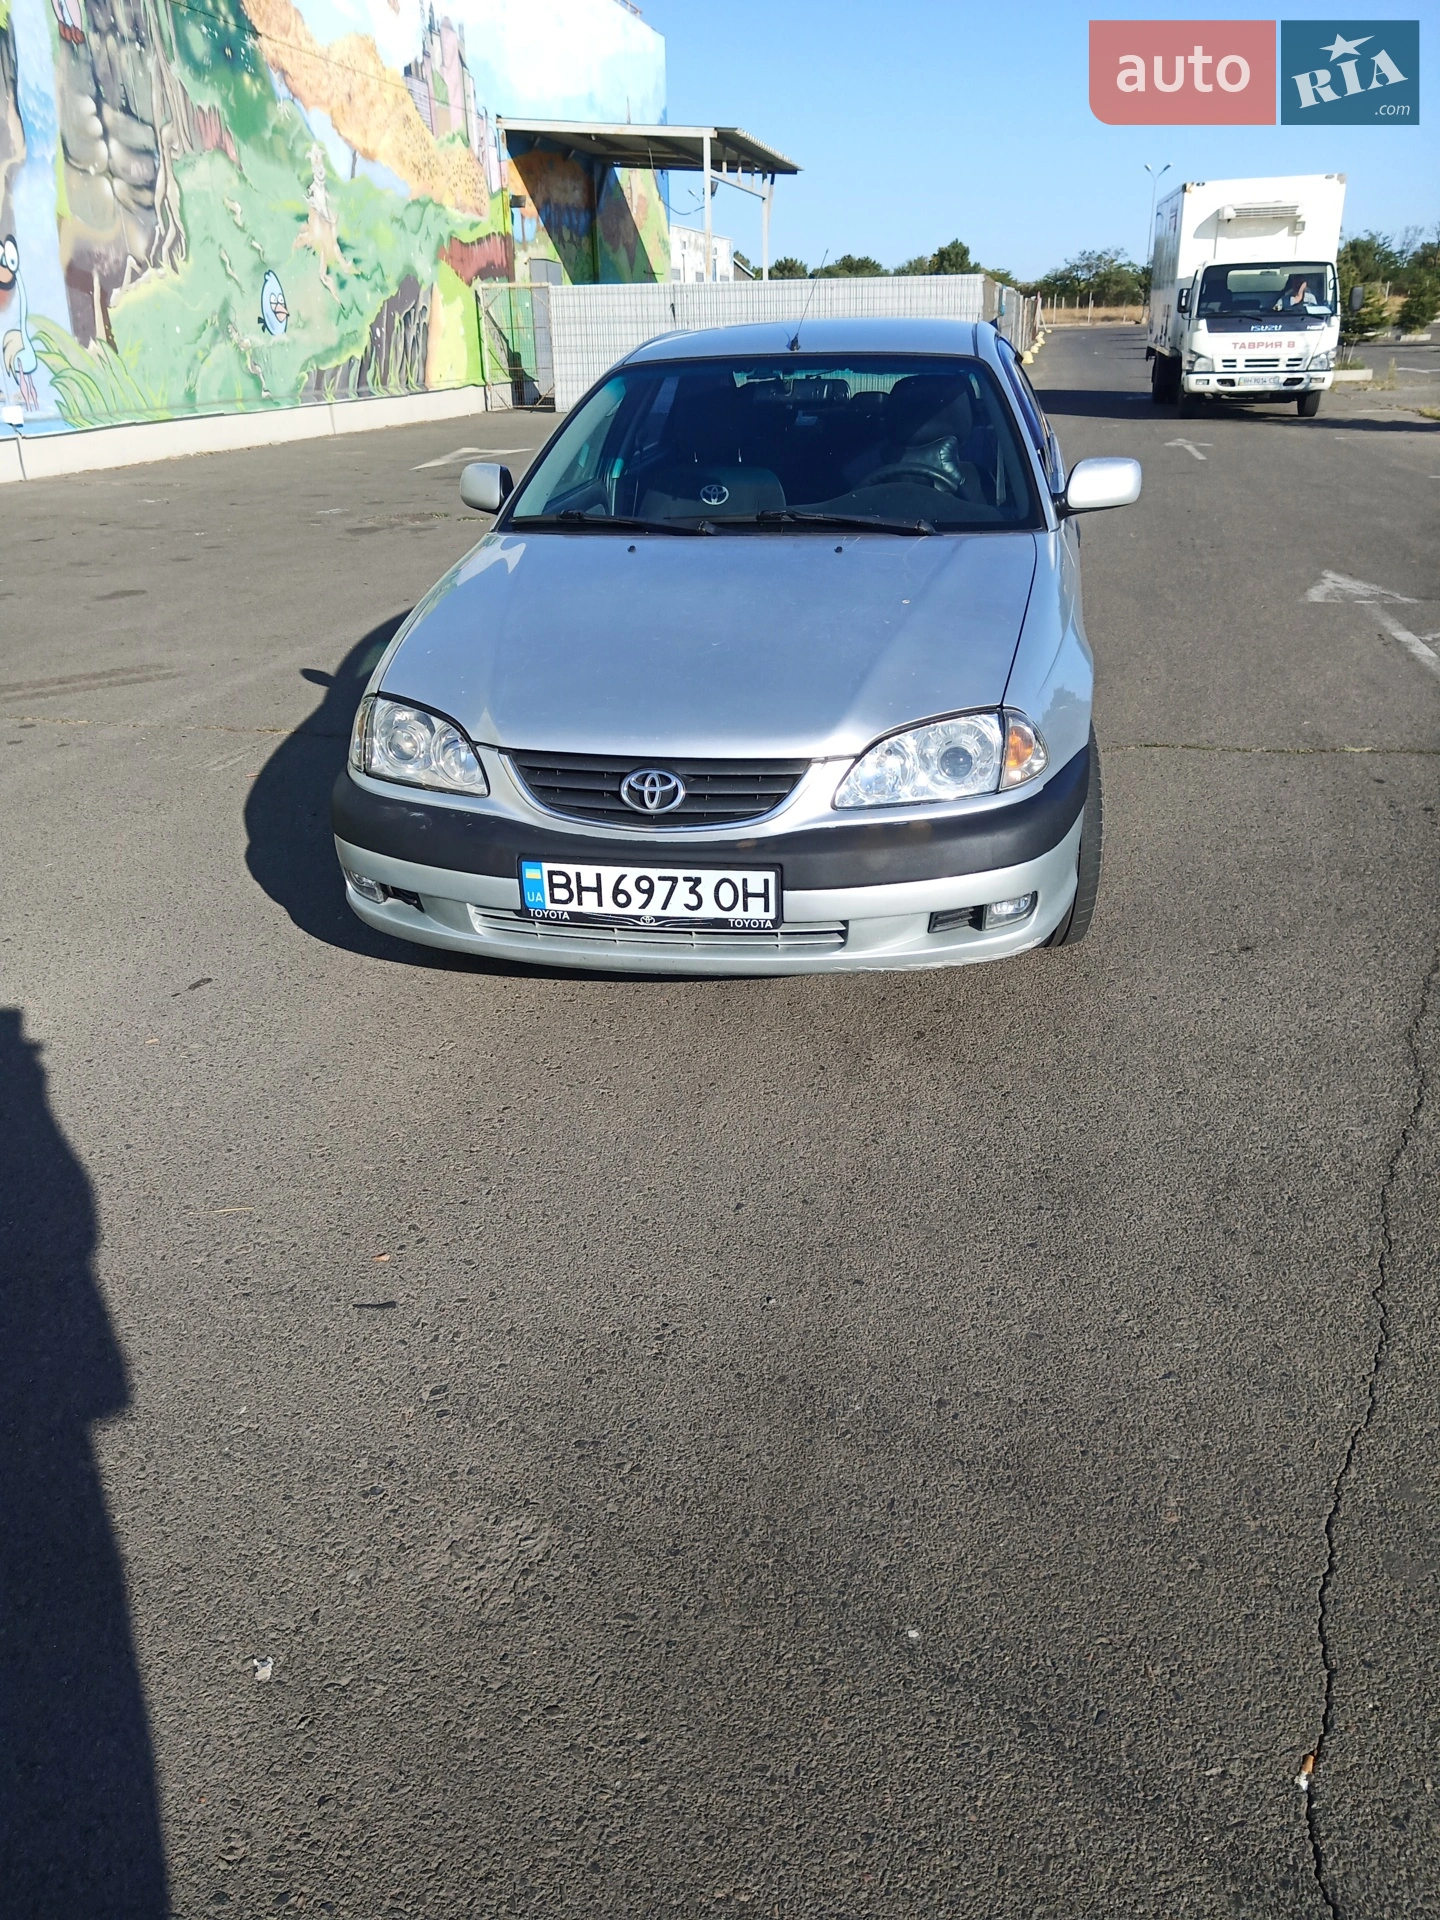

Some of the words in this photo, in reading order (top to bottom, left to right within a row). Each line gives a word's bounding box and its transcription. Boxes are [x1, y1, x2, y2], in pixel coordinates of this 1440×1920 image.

[1232, 341, 1282, 350] ТАВРИЯ
[527, 891, 544, 904] UA
[547, 869, 604, 908] BH
[611, 873, 704, 912] 6973
[713, 877, 770, 913] OH
[528, 908, 571, 921] TOYOTA
[727, 918, 773, 929] TOYOTA
